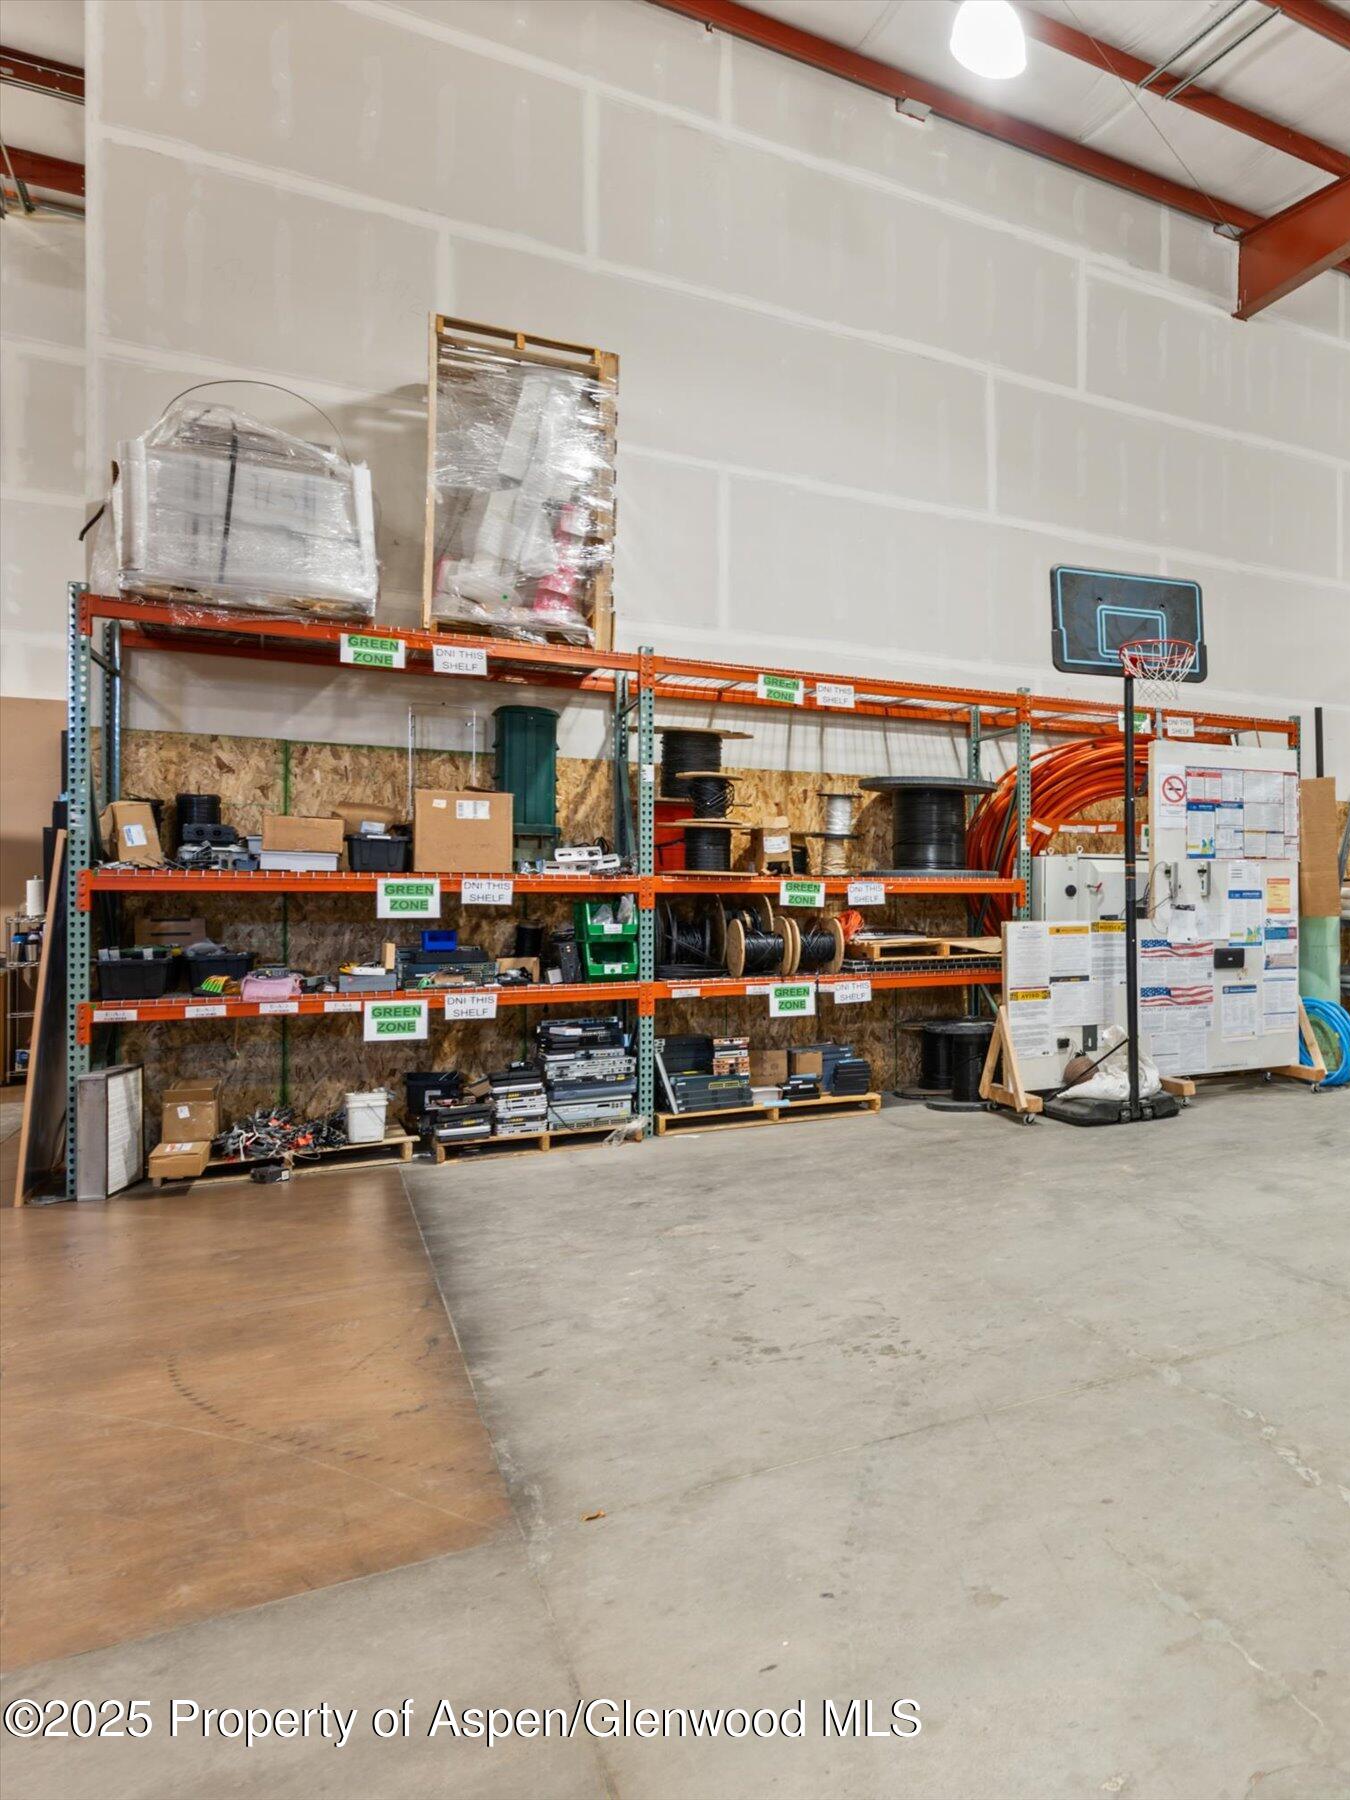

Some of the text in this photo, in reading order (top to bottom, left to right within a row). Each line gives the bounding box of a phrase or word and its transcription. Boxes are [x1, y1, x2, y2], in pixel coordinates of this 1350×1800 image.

[348, 635, 399, 652] GREEN
[353, 651, 393, 666] ZONE
[459, 650, 485, 661] THIS
[442, 660, 479, 672] SHELF
[763, 675, 800, 690] GREEN
[766, 688, 795, 702] ZONE
[384, 884, 434, 895] GREEN
[464, 881, 511, 891] DNI THIS
[785, 882, 821, 893] GREEN
[469, 893, 505, 902] SHELF
[788, 895, 816, 905] ZONE
[390, 900, 429, 911] ZONE
[774, 987, 810, 998] GREEN
[447, 996, 495, 1006] DNI THIS
[778, 1000, 806, 1010] ZONE
[371, 1006, 422, 1018] GREEN
[453, 1008, 489, 1018] SHELF
[377, 1021, 416, 1033] ZONE
